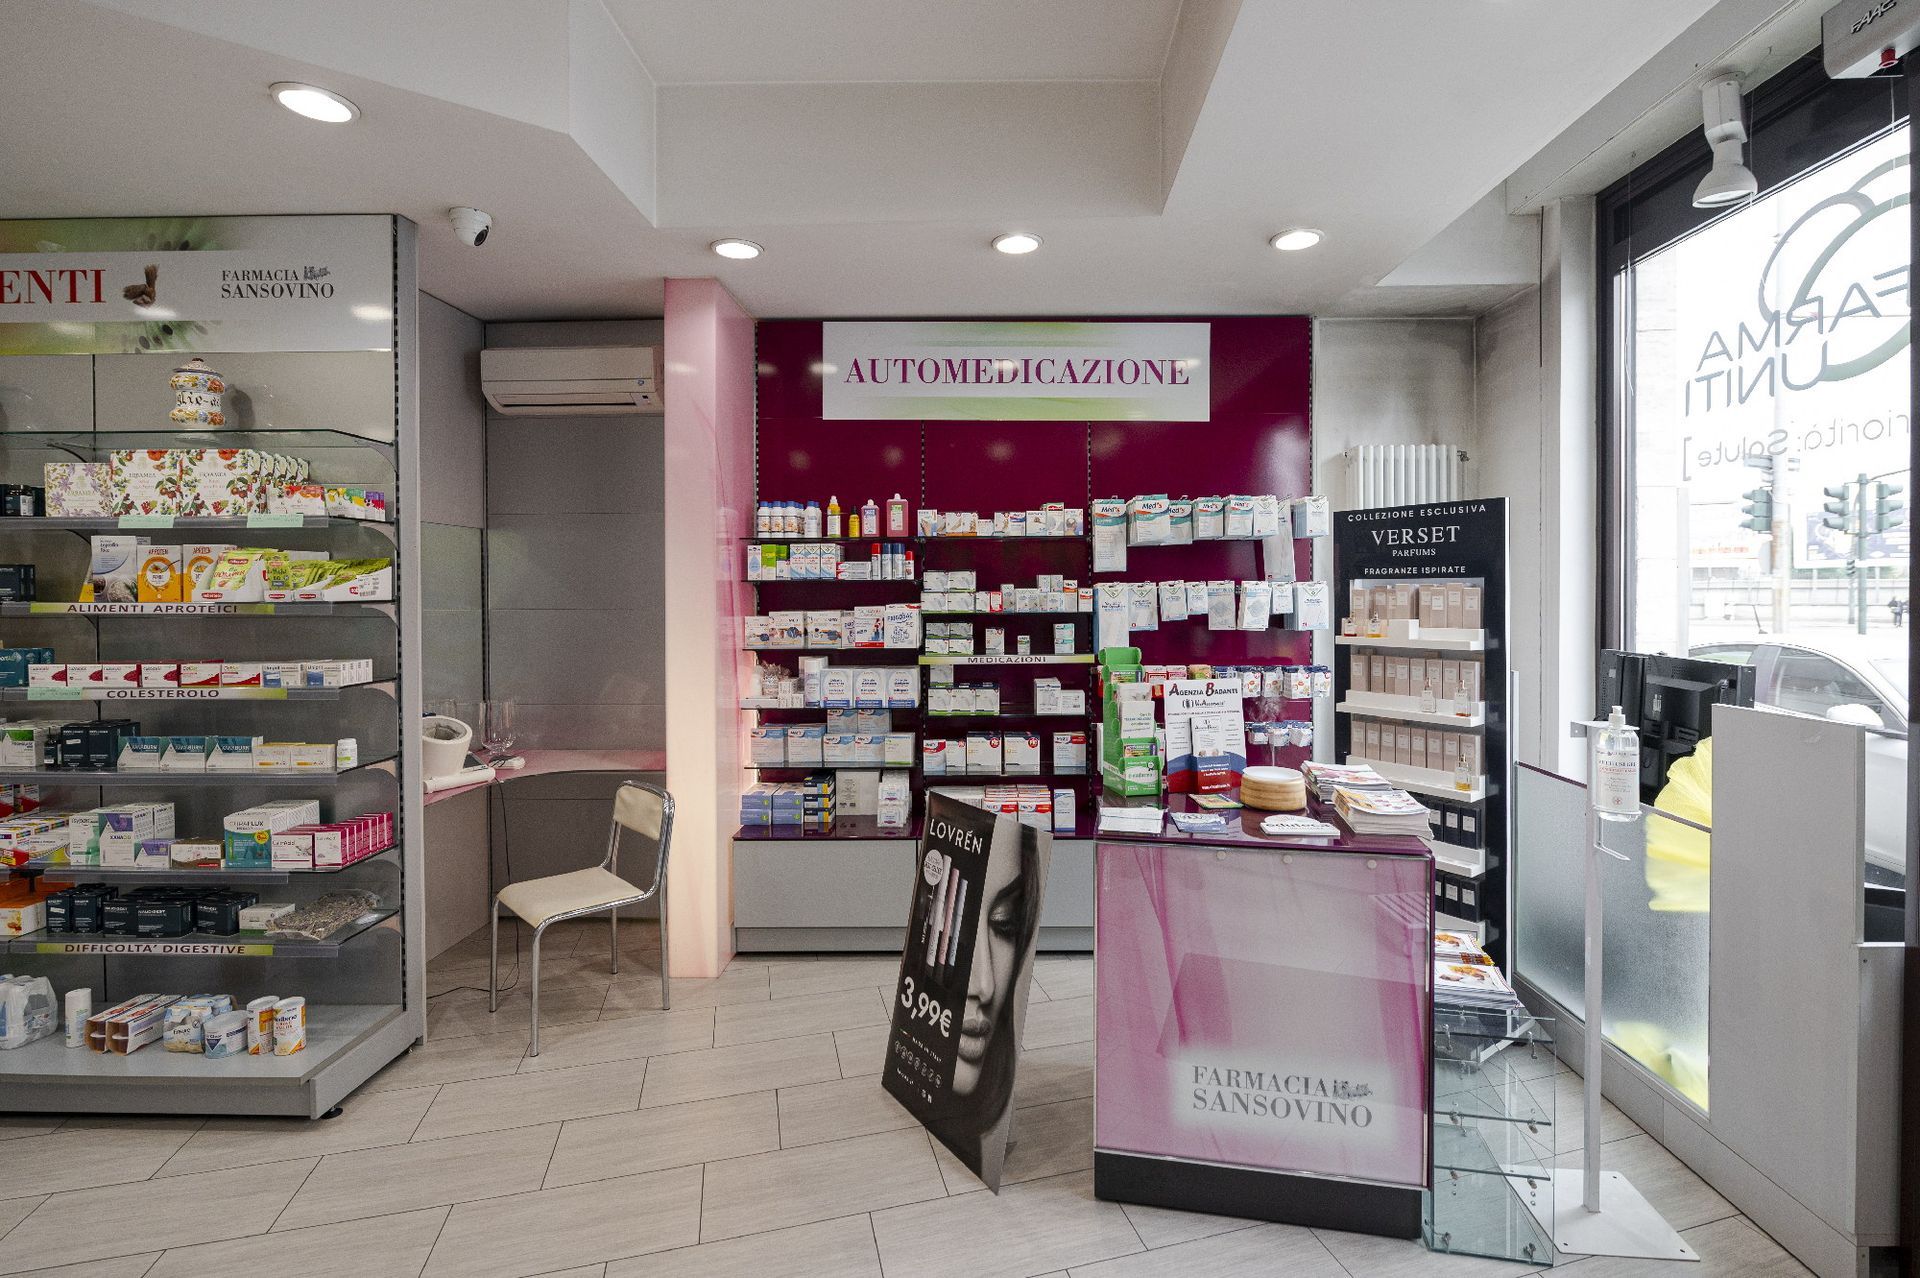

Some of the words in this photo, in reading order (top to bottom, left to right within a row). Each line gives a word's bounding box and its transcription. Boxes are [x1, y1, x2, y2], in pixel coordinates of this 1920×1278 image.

[1851, 0, 1897, 34] FAAC
[221, 269, 300, 281] FARMACIA
[0, 269, 106, 304] ENTI
[221, 282, 334, 299] SANSOVINO
[844, 357, 1190, 386] AUTOMEDICAZIONE
[1142, 502, 1163, 510] Med's
[1347, 510, 1414, 522] COLLEZIONE
[1420, 504, 1486, 517] ESCLUSIVA
[1371, 525, 1460, 546] VERSET
[1392, 548, 1436, 557] PARFUMS
[1364, 566, 1418, 576] FRAGRANZE
[1421, 565, 1466, 575] ISPIRATE
[67, 604, 144, 613] ALIMENTI
[153, 604, 238, 613] APROTEICI
[967, 656, 1046, 664] MEDICAZIONI
[106, 689, 219, 699] COLESTEROLO
[162, 944, 246, 955] DIGESTIVE
[901, 975, 952, 1038] 3,99€
[1192, 1065, 1329, 1098] FARMACIA
[1192, 1087, 1373, 1129] SANSOVINO
